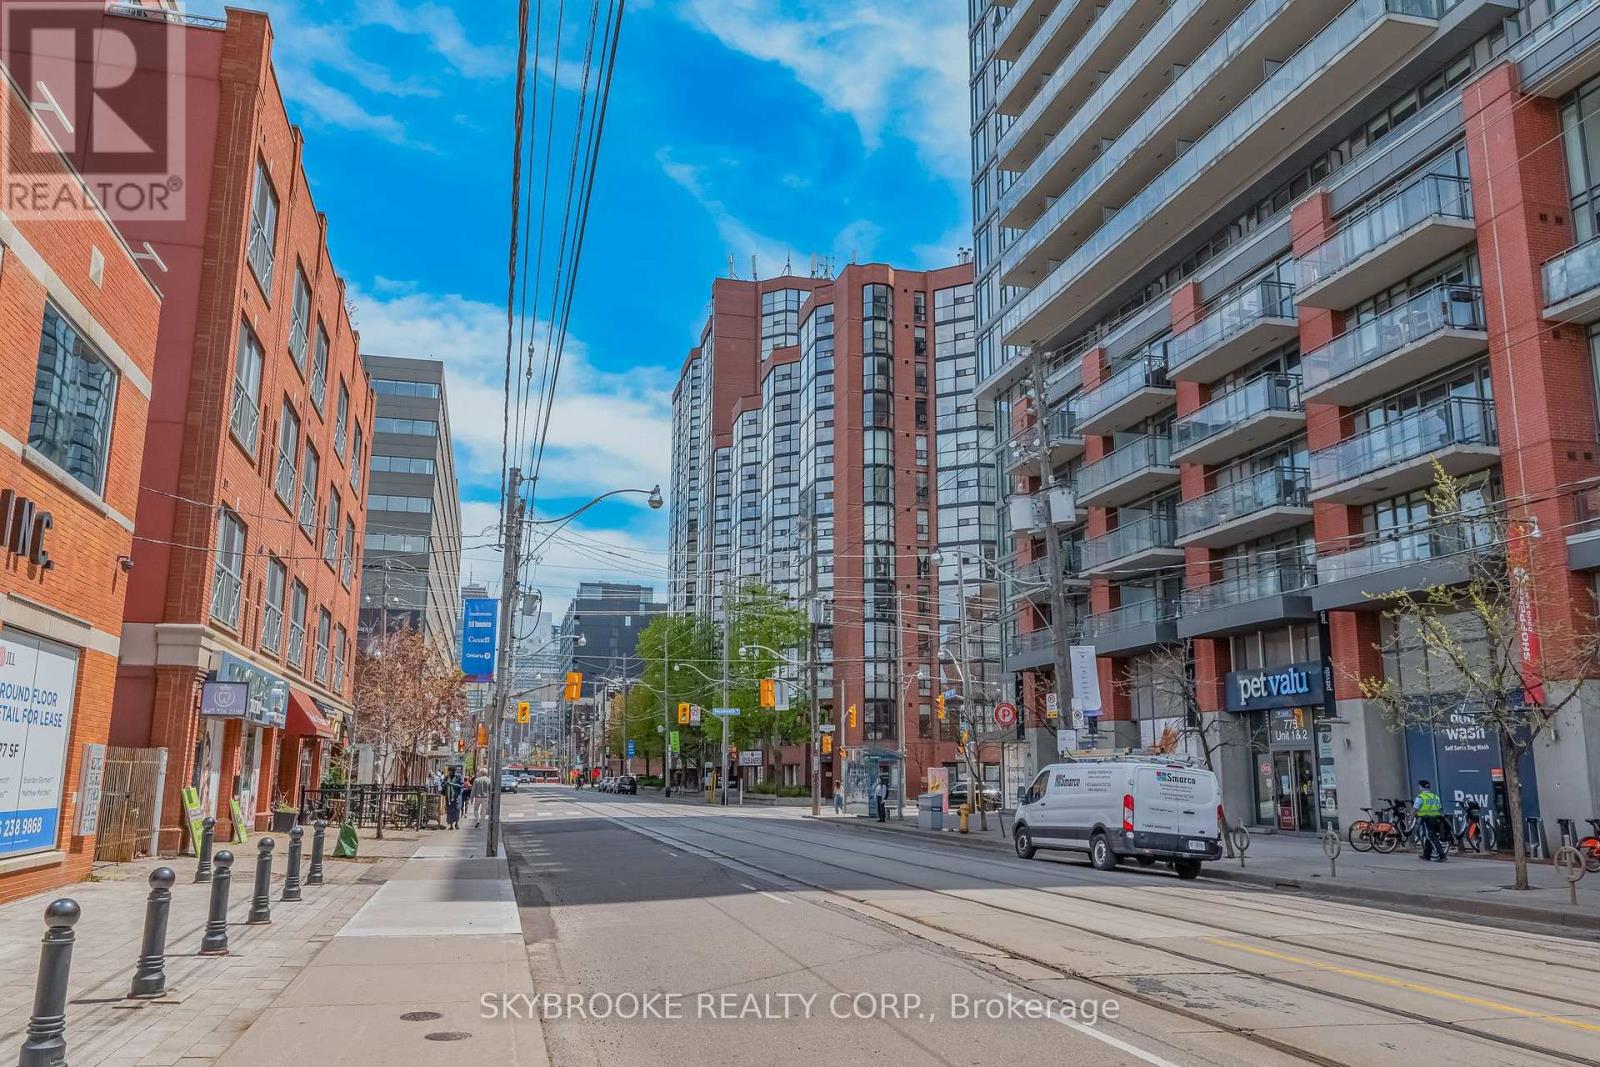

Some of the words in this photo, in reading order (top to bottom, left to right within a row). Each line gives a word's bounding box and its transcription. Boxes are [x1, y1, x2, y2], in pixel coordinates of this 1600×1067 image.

[5, 651, 16, 666] JLL
[31, 689, 58, 707] FLOOR
[22, 708, 39, 725] FOR
[40, 711, 63, 728] LEASE
[1276, 731, 1290, 742] Unit
[9, 743, 20, 758] SF
[3, 819, 21, 837] 238
[22, 817, 42, 834] 9868
